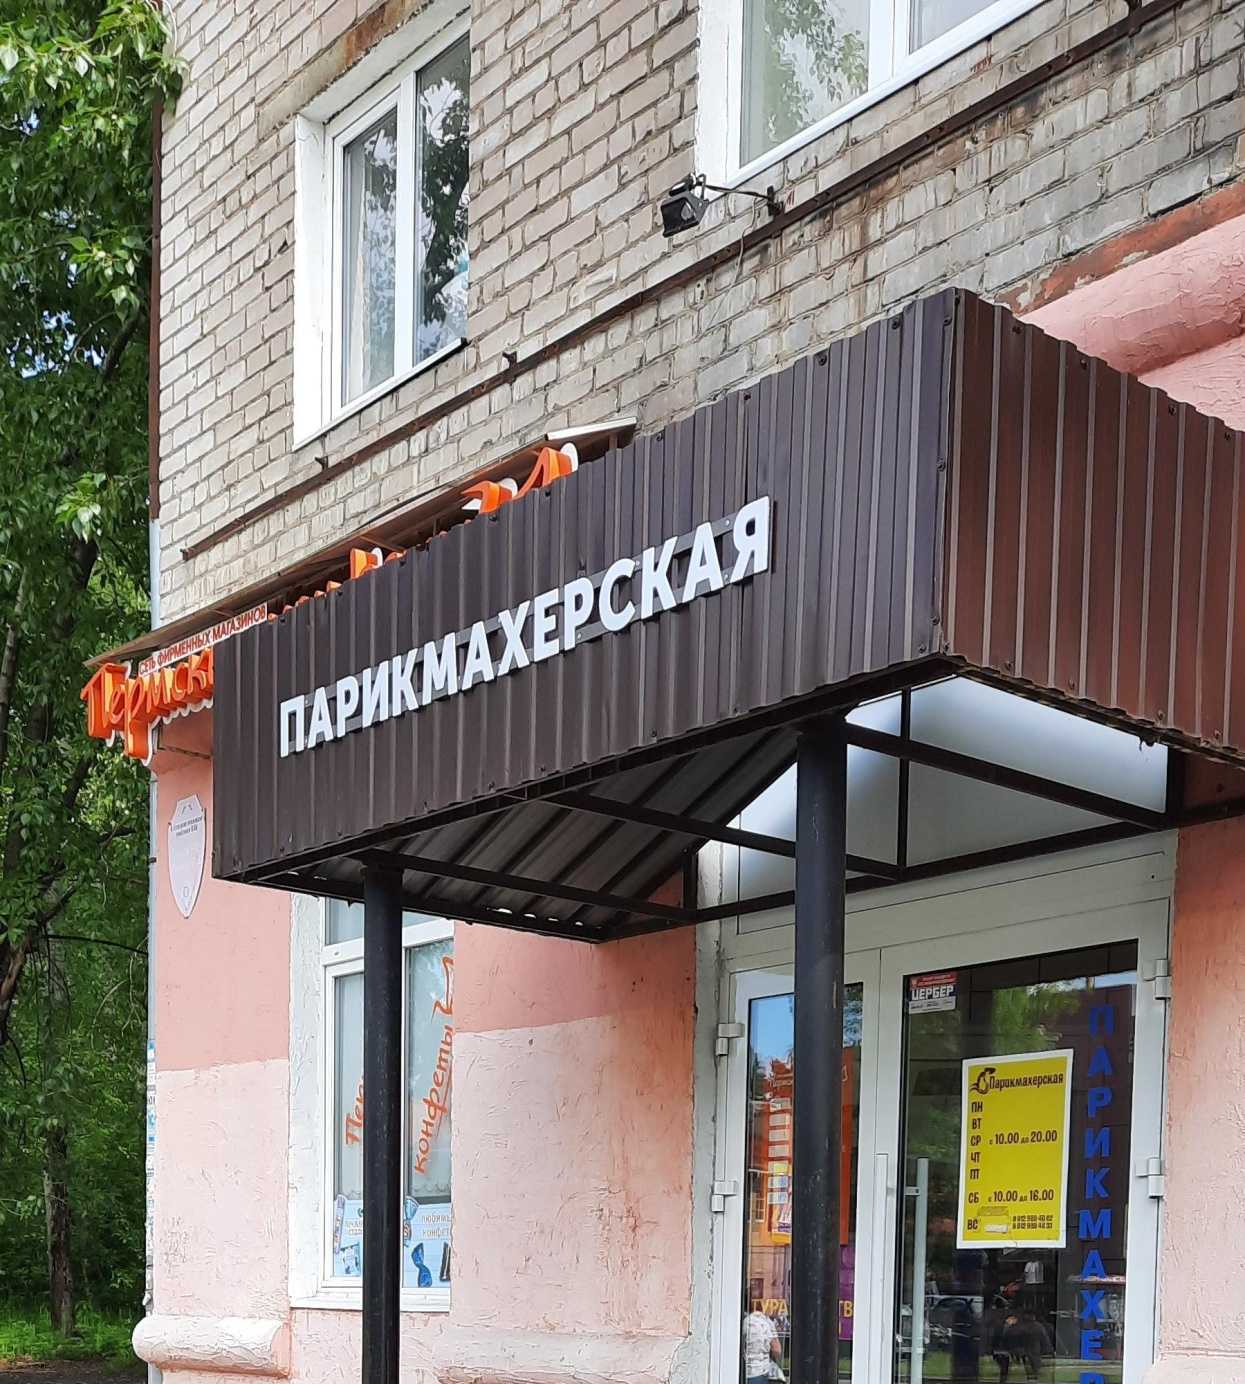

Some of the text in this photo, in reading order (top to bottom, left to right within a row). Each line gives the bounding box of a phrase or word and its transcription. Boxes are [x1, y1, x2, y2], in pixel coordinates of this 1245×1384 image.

[280, 495, 771, 758] ПАРИКМАХЕРСКАЯ
[139, 604, 266, 675] СЕТЬ ФИРМЕННЫХ МАГАЗИНОВ
[989, 1072, 1064, 1092] Парикмахерская
[415, 1024, 454, 1174] конфеты
[971, 1101, 983, 1113] ПН
[972, 1118, 982, 1130] ВТ
[970, 1135, 981, 1146] СР
[995, 1132, 1019, 1145] 10.00
[1030, 1130, 1057, 1143] 20.00
[970, 1152, 981, 1163] ЧТ
[970, 1168, 980, 1180] ПТ
[968, 1192, 979, 1204] СБ
[994, 1190, 1018, 1202] 10.00
[1029, 1189, 1054, 1201] 16.00
[967, 1218, 978, 1230] ВС
